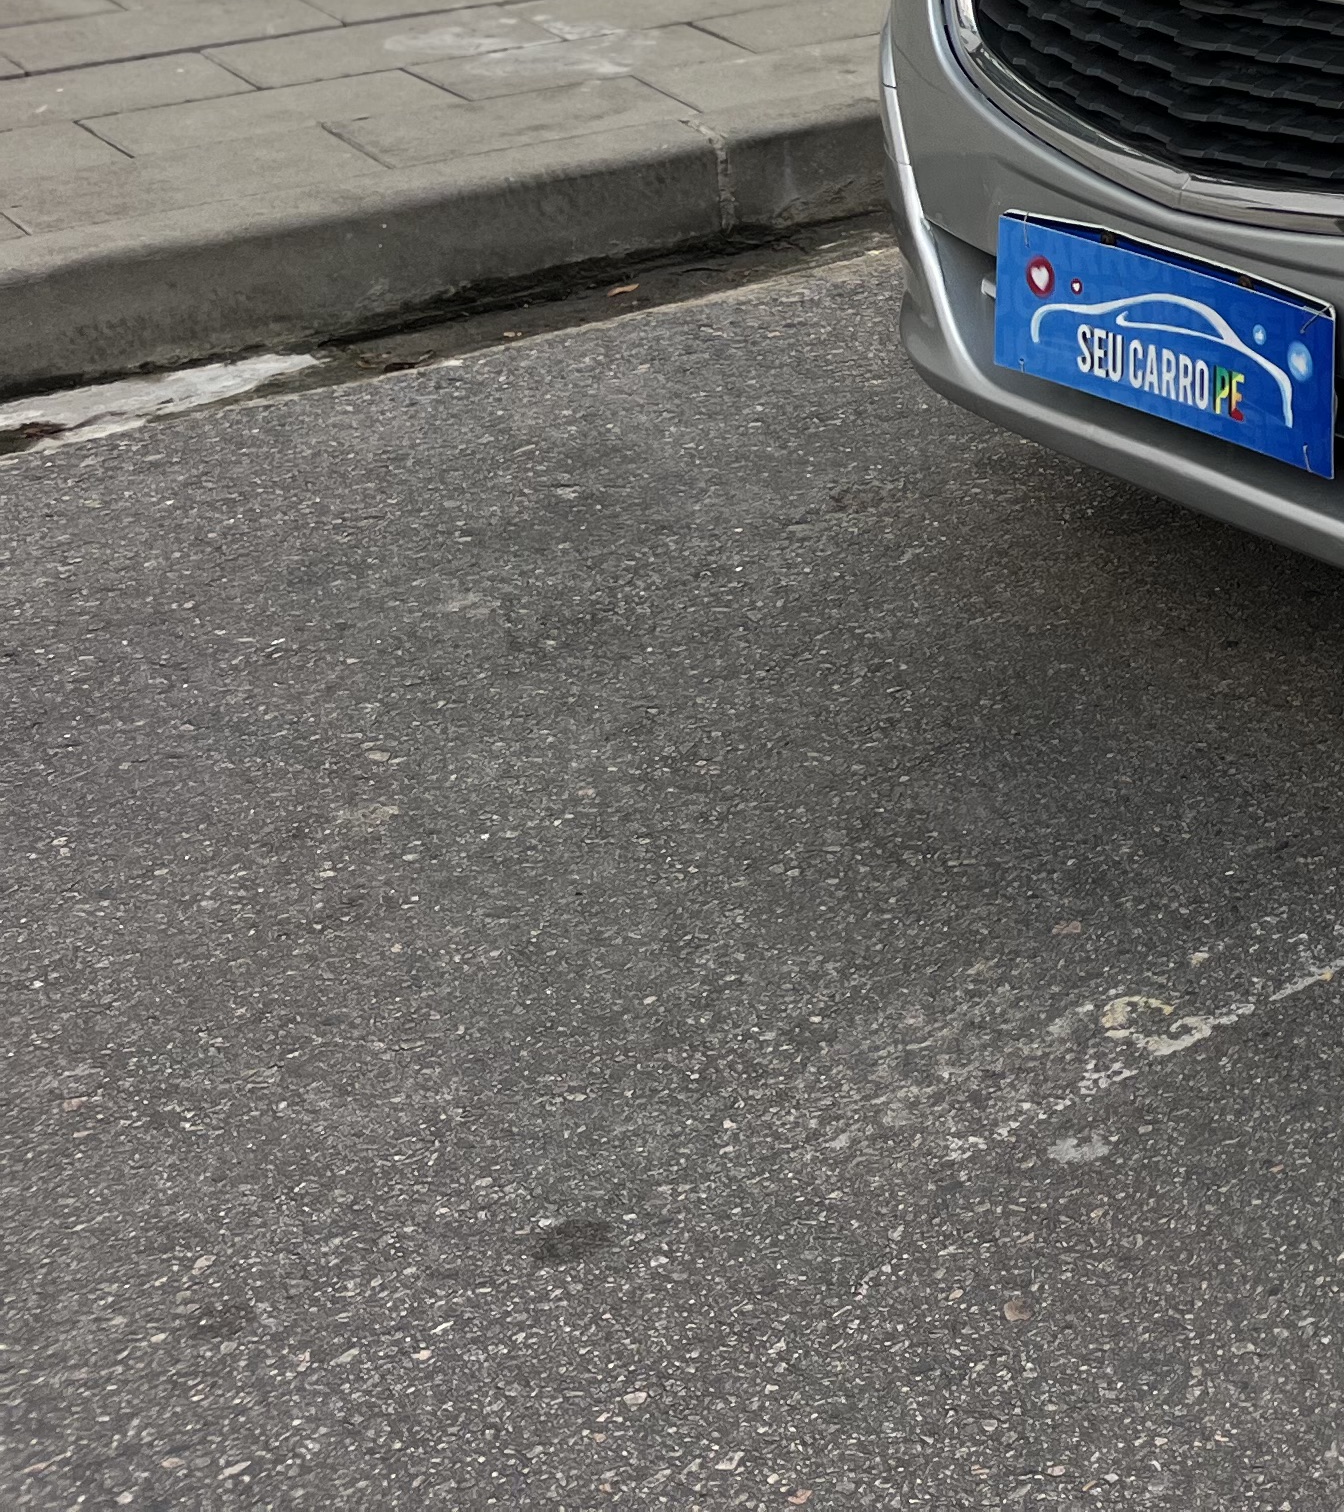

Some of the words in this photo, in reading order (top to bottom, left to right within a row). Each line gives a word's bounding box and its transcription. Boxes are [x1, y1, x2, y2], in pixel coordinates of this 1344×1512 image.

[1076, 324, 1124, 383] SEU
[1129, 339, 1210, 411] CARRO
[1214, 365, 1246, 423] PE
